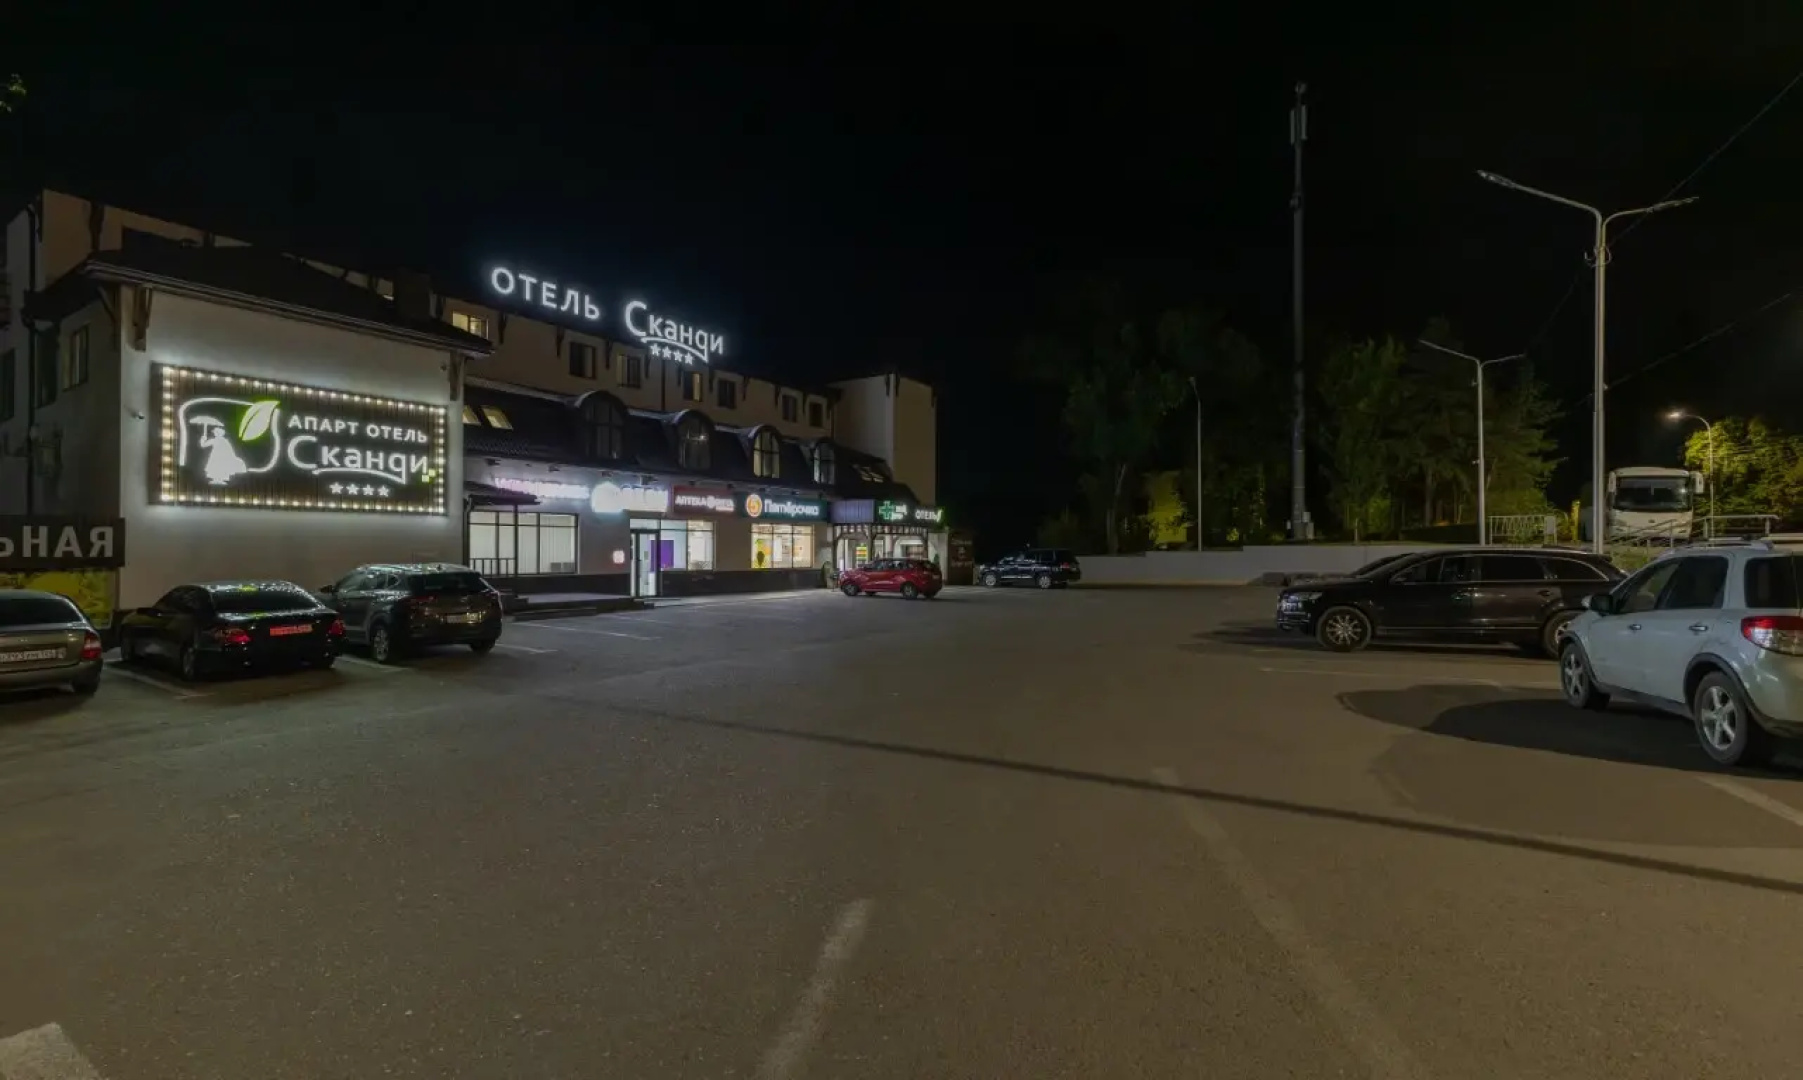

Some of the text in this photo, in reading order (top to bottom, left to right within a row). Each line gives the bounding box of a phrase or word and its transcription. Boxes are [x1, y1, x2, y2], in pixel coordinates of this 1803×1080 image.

[491, 267, 724, 363] ОТЕЛЬ Сканди
[288, 414, 428, 443] АПАРТ ОТЕЛЬ
[287, 435, 428, 485] Сканди
